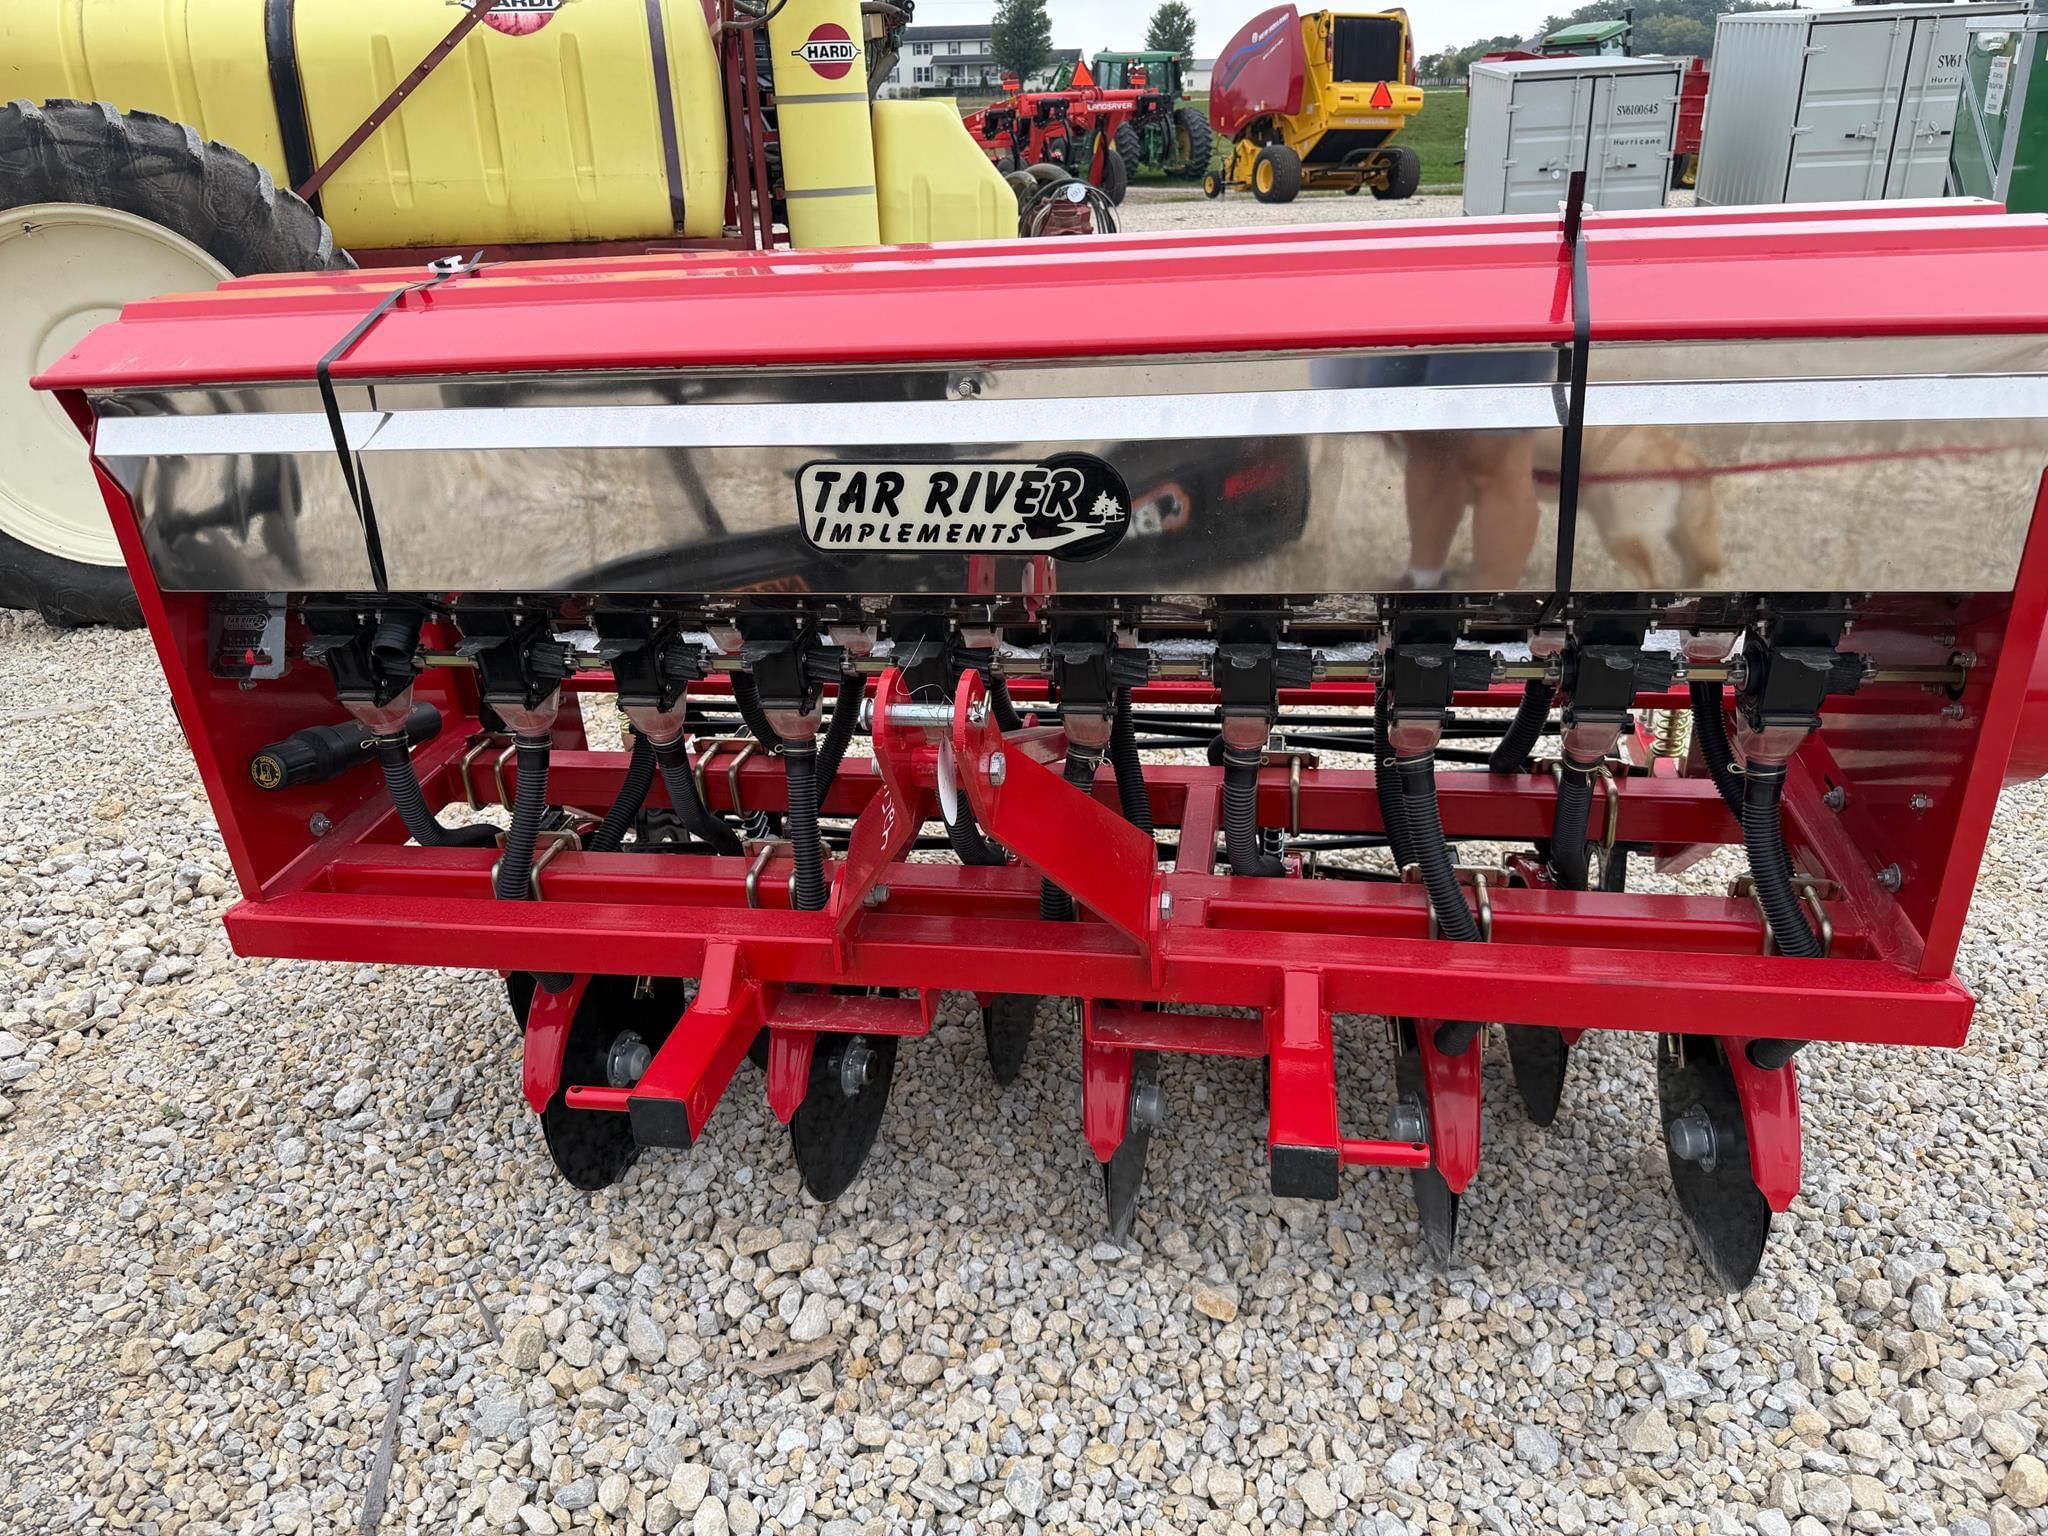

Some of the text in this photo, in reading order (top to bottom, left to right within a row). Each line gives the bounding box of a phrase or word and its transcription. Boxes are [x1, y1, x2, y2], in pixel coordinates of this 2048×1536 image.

[807, 45, 852, 59] HARDI
[1616, 103, 1659, 116] SV6100645
[814, 470, 1083, 519] TAR RIVER
